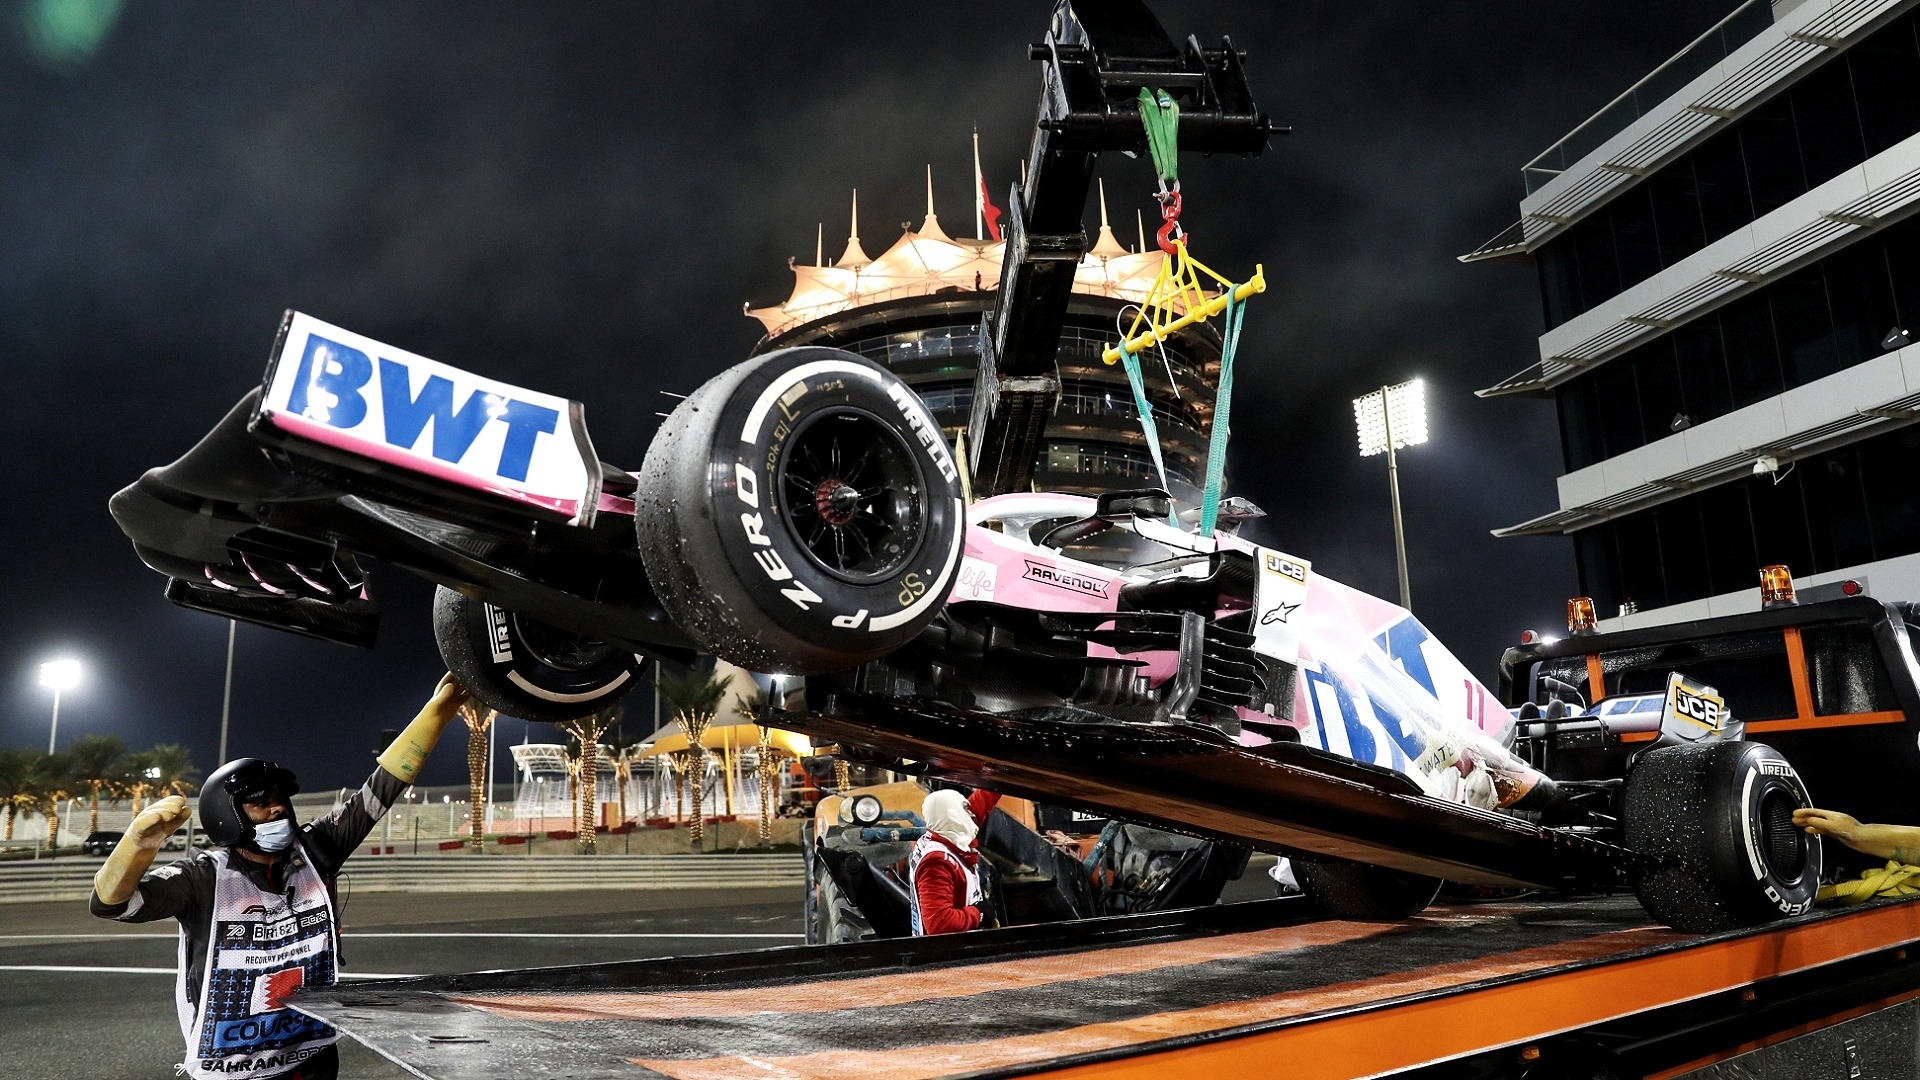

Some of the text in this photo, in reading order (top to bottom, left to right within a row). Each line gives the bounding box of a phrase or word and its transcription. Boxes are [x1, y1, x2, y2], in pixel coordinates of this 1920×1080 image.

[286, 333, 560, 483] BWT
[887, 381, 959, 484] PIRELLI
[734, 462, 824, 611] ZERO
[956, 566, 995, 597] life
[1031, 566, 1103, 593] RAVENOL
[1268, 555, 1305, 582] JCB
[1676, 688, 1719, 728] JCB
[1755, 758, 1795, 778] PIRELLI
[1764, 885, 1812, 916] ZERO
[200, 1055, 285, 1073] BAHRAIN
